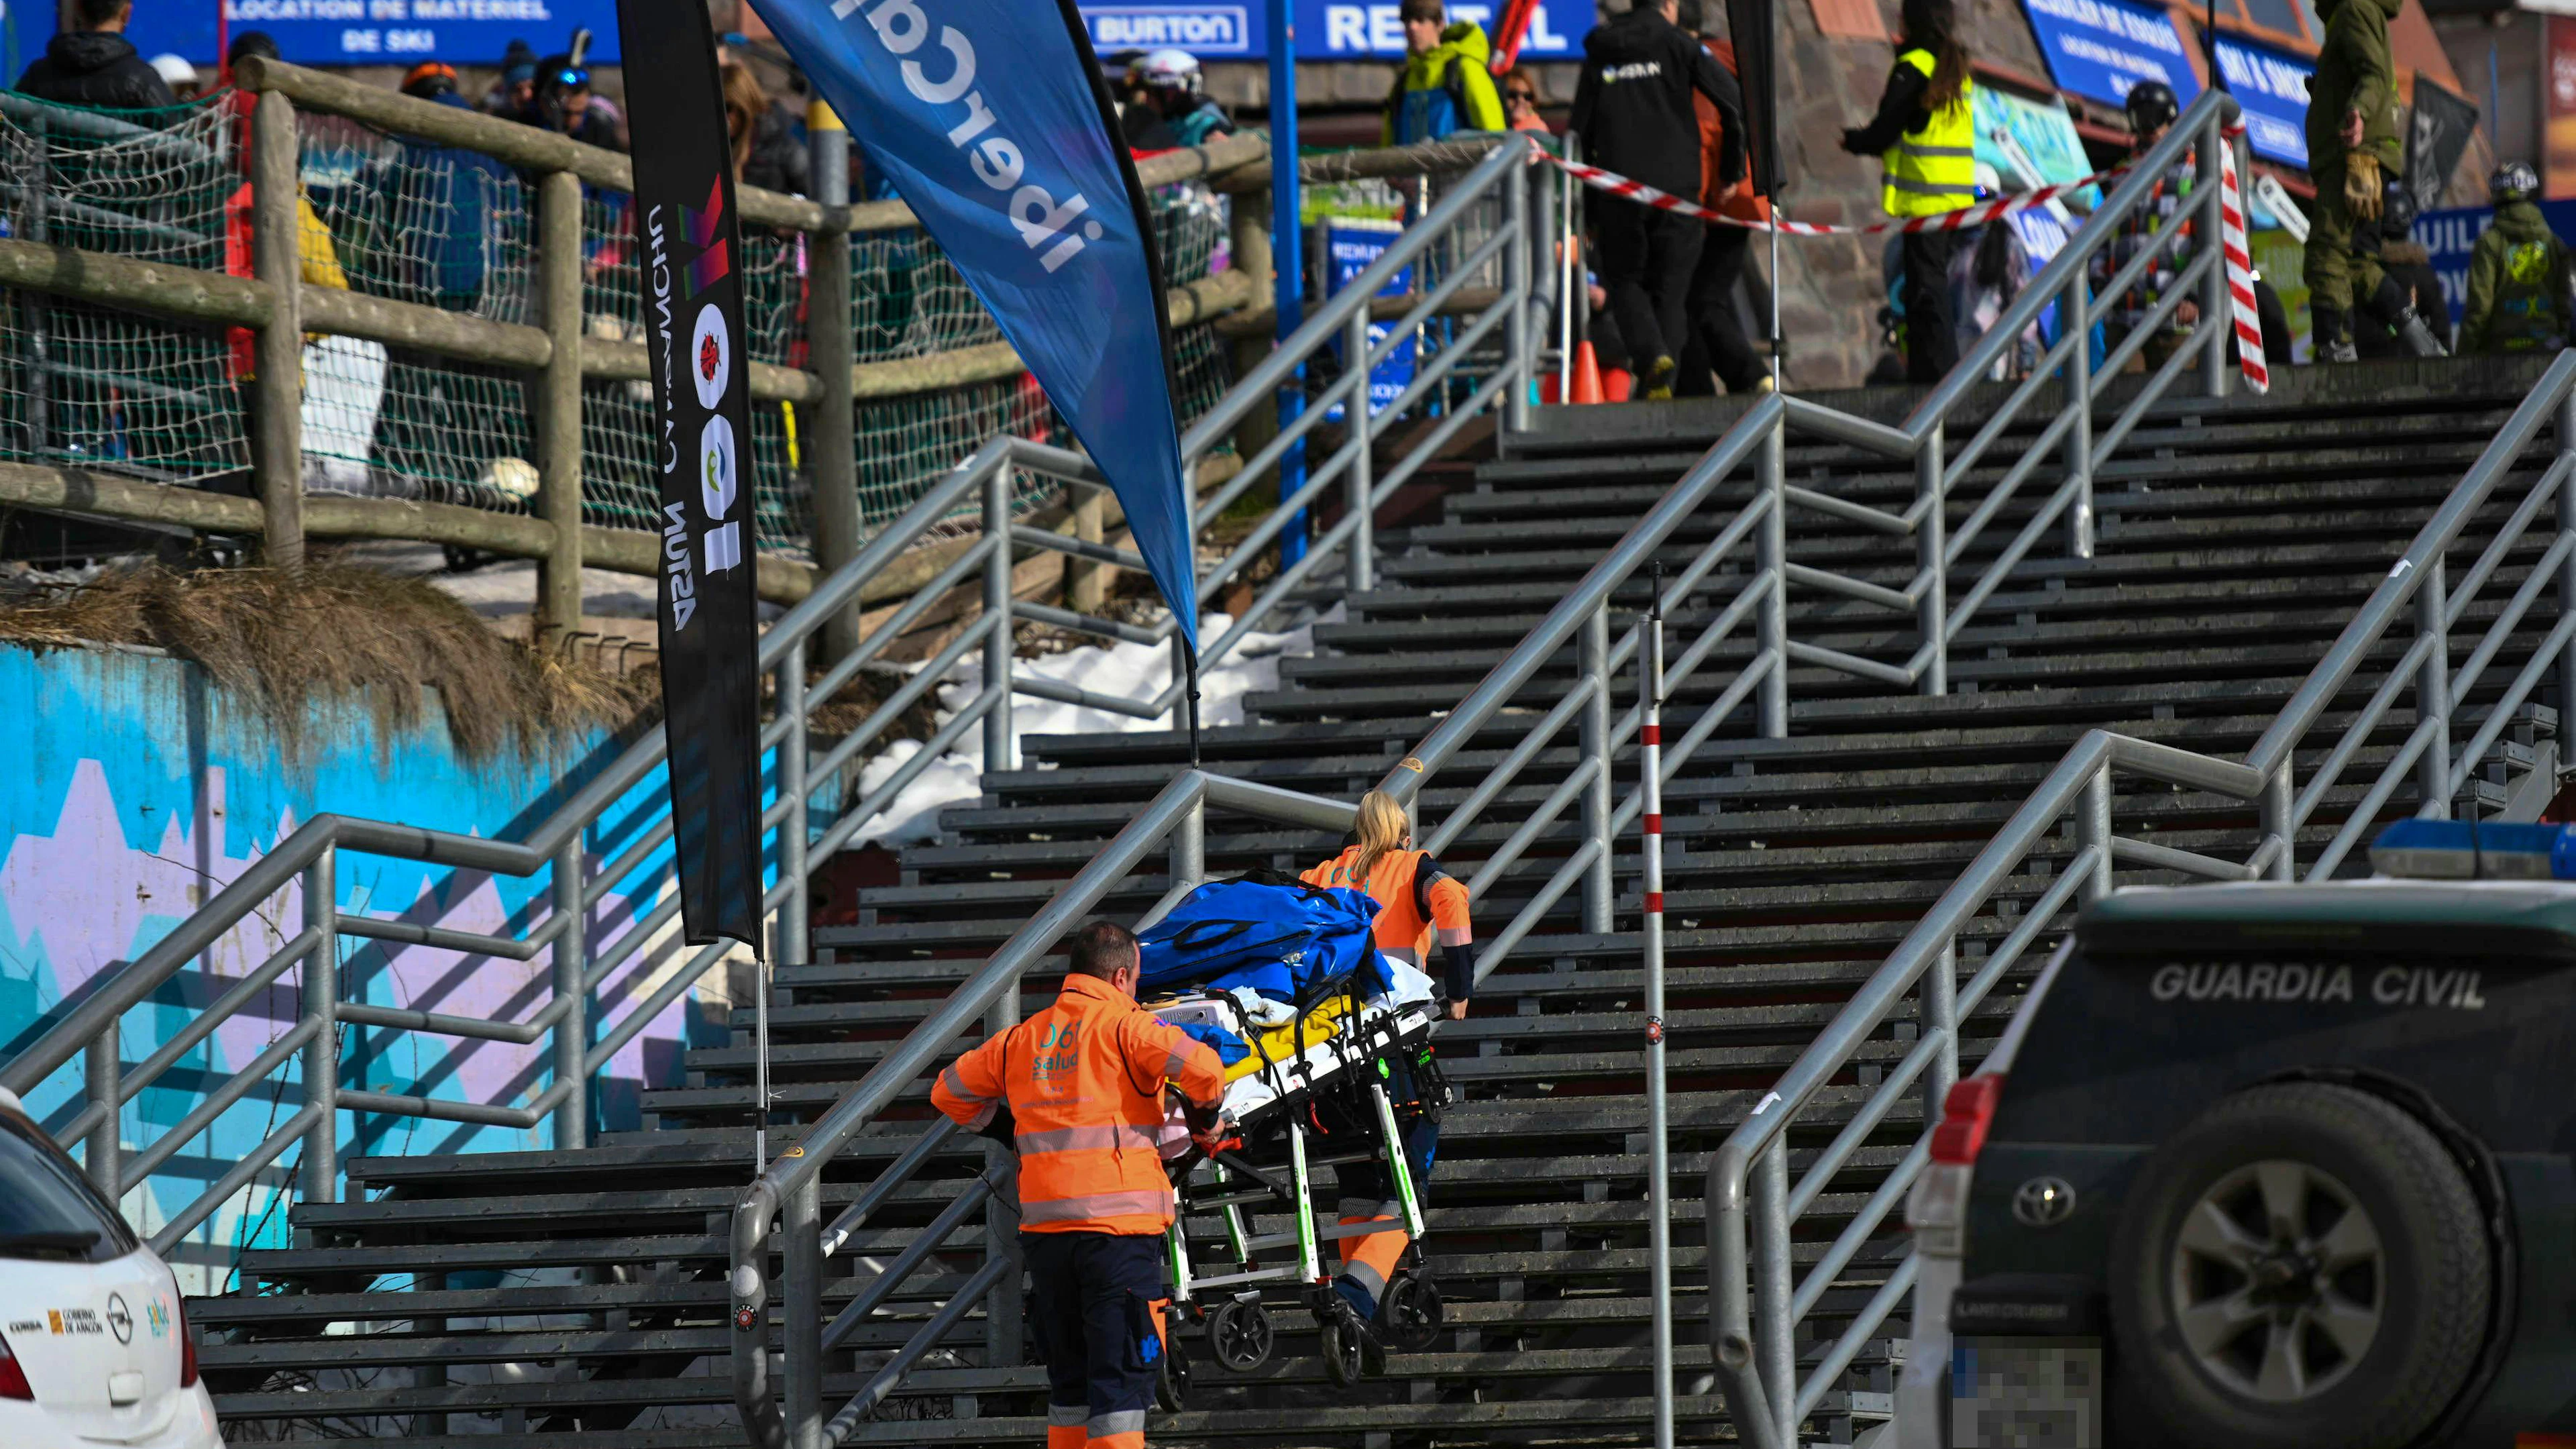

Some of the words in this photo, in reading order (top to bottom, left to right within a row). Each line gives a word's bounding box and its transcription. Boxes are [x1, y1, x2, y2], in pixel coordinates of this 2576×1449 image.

[223, 0, 364, 20] LOCATION
[370, 0, 408, 20] DE
[341, 29, 380, 52] DE
[384, 29, 435, 52] SKI
[1097, 17, 1233, 42] BURTON
[2215, 41, 2255, 90] SKI
[2150, 963, 2354, 1002] GUARDIA
[2371, 967, 2487, 1009] CIVIL
[1032, 1051, 1079, 1071] salud
[65, 1322, 73, 1334] DE
